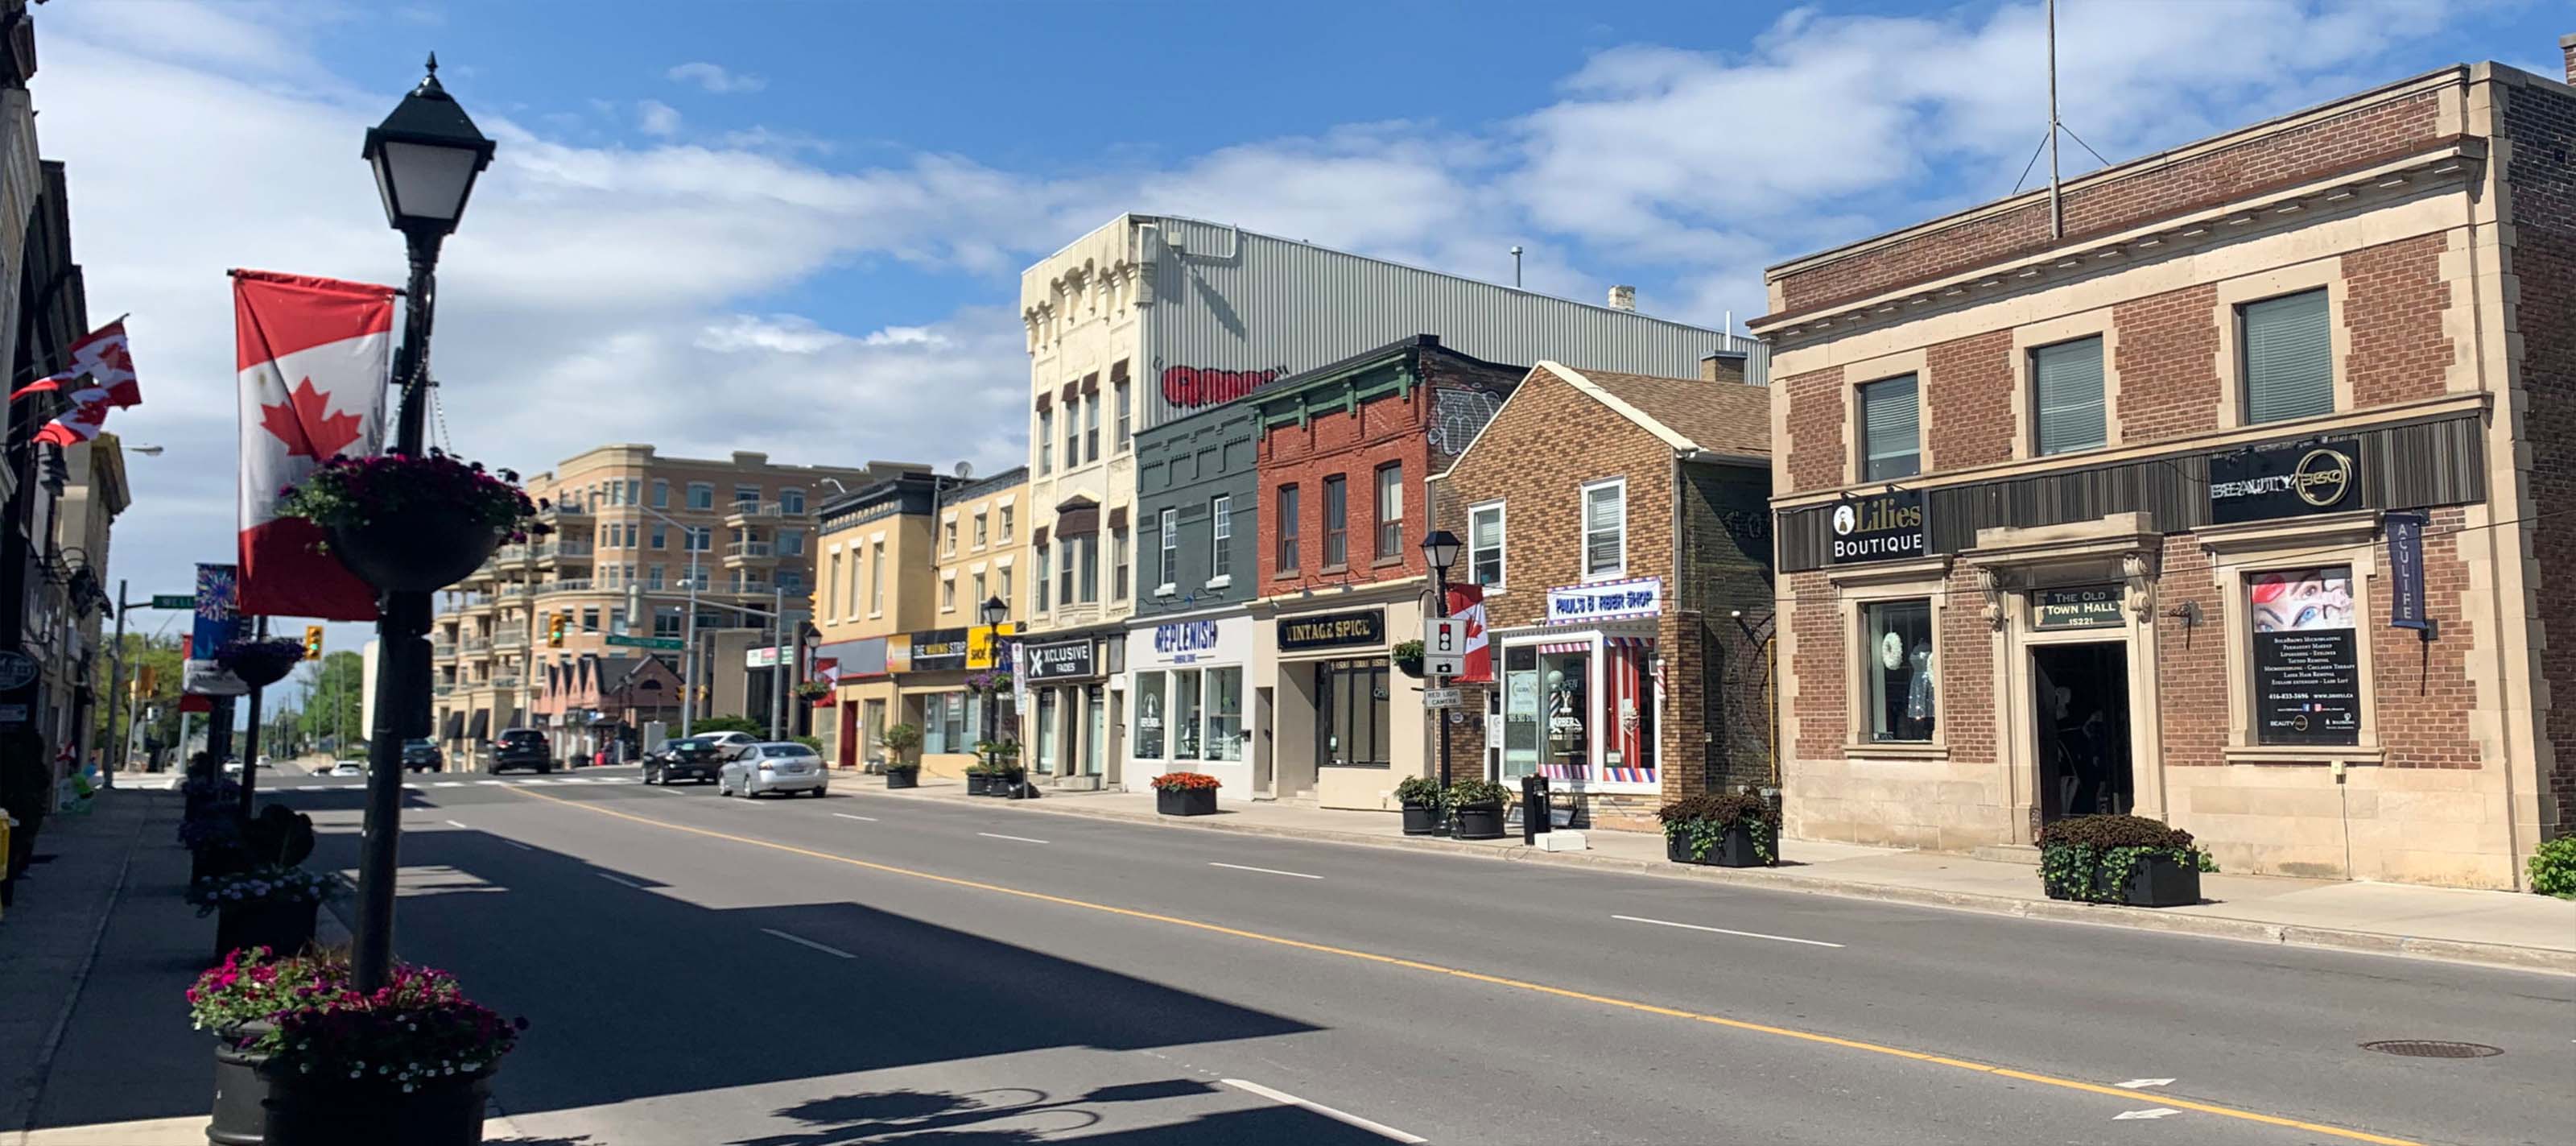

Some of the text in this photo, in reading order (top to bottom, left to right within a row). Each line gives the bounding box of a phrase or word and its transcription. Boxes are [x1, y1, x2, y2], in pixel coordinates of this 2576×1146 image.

[2210, 474, 2296, 499] BEAUTY
[1854, 499, 1922, 533] Lilies
[1835, 534, 1922, 557] BOUTIQUE
[2399, 523, 2412, 619] ACULIFE
[1556, 597, 1585, 614] PAUL'S
[1627, 590, 1653, 608] SHOP
[2046, 602, 2116, 614] TOWN HALL
[2054, 591, 2106, 603] THE OLD
[1287, 619, 1371, 641] VINTAGE SPICE
[2069, 617, 2093, 625] 15221
[1156, 619, 1217, 653] REPLENISH
[1043, 645, 1088, 663] XCLUSIVE
[1055, 663, 1075, 672] FADES
